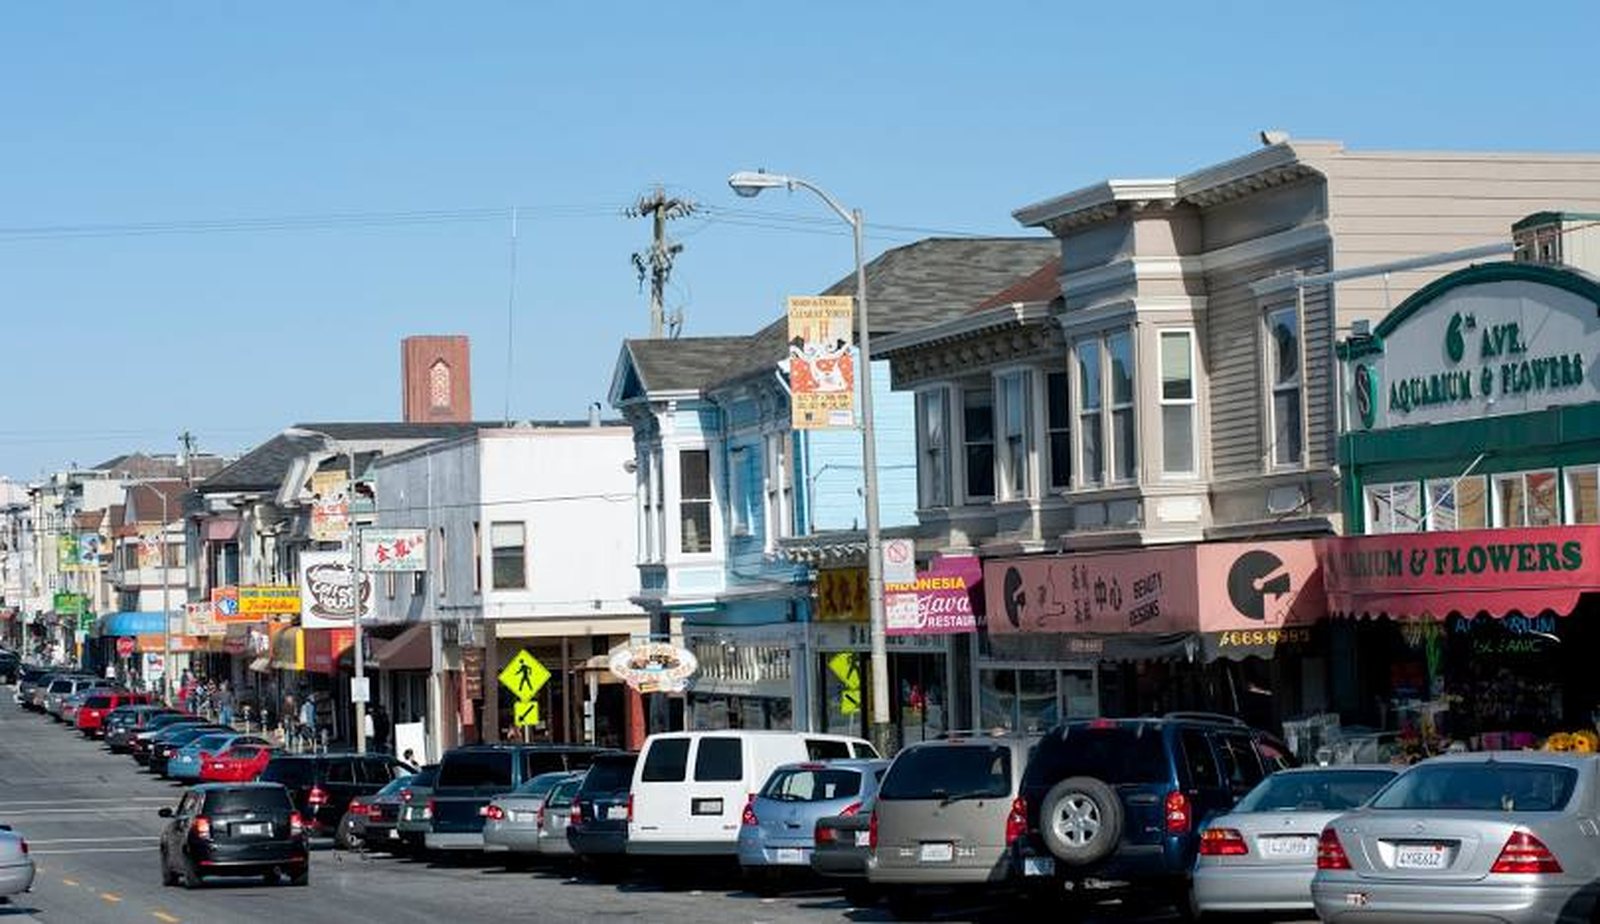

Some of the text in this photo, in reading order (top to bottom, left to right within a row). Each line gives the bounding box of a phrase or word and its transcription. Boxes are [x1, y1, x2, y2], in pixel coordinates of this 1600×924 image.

[1389, 353, 1584, 413] AQUARIUM & FLOWERS
[1409, 546, 1428, 577] &
[1434, 541, 1583, 576] FLOWERS
